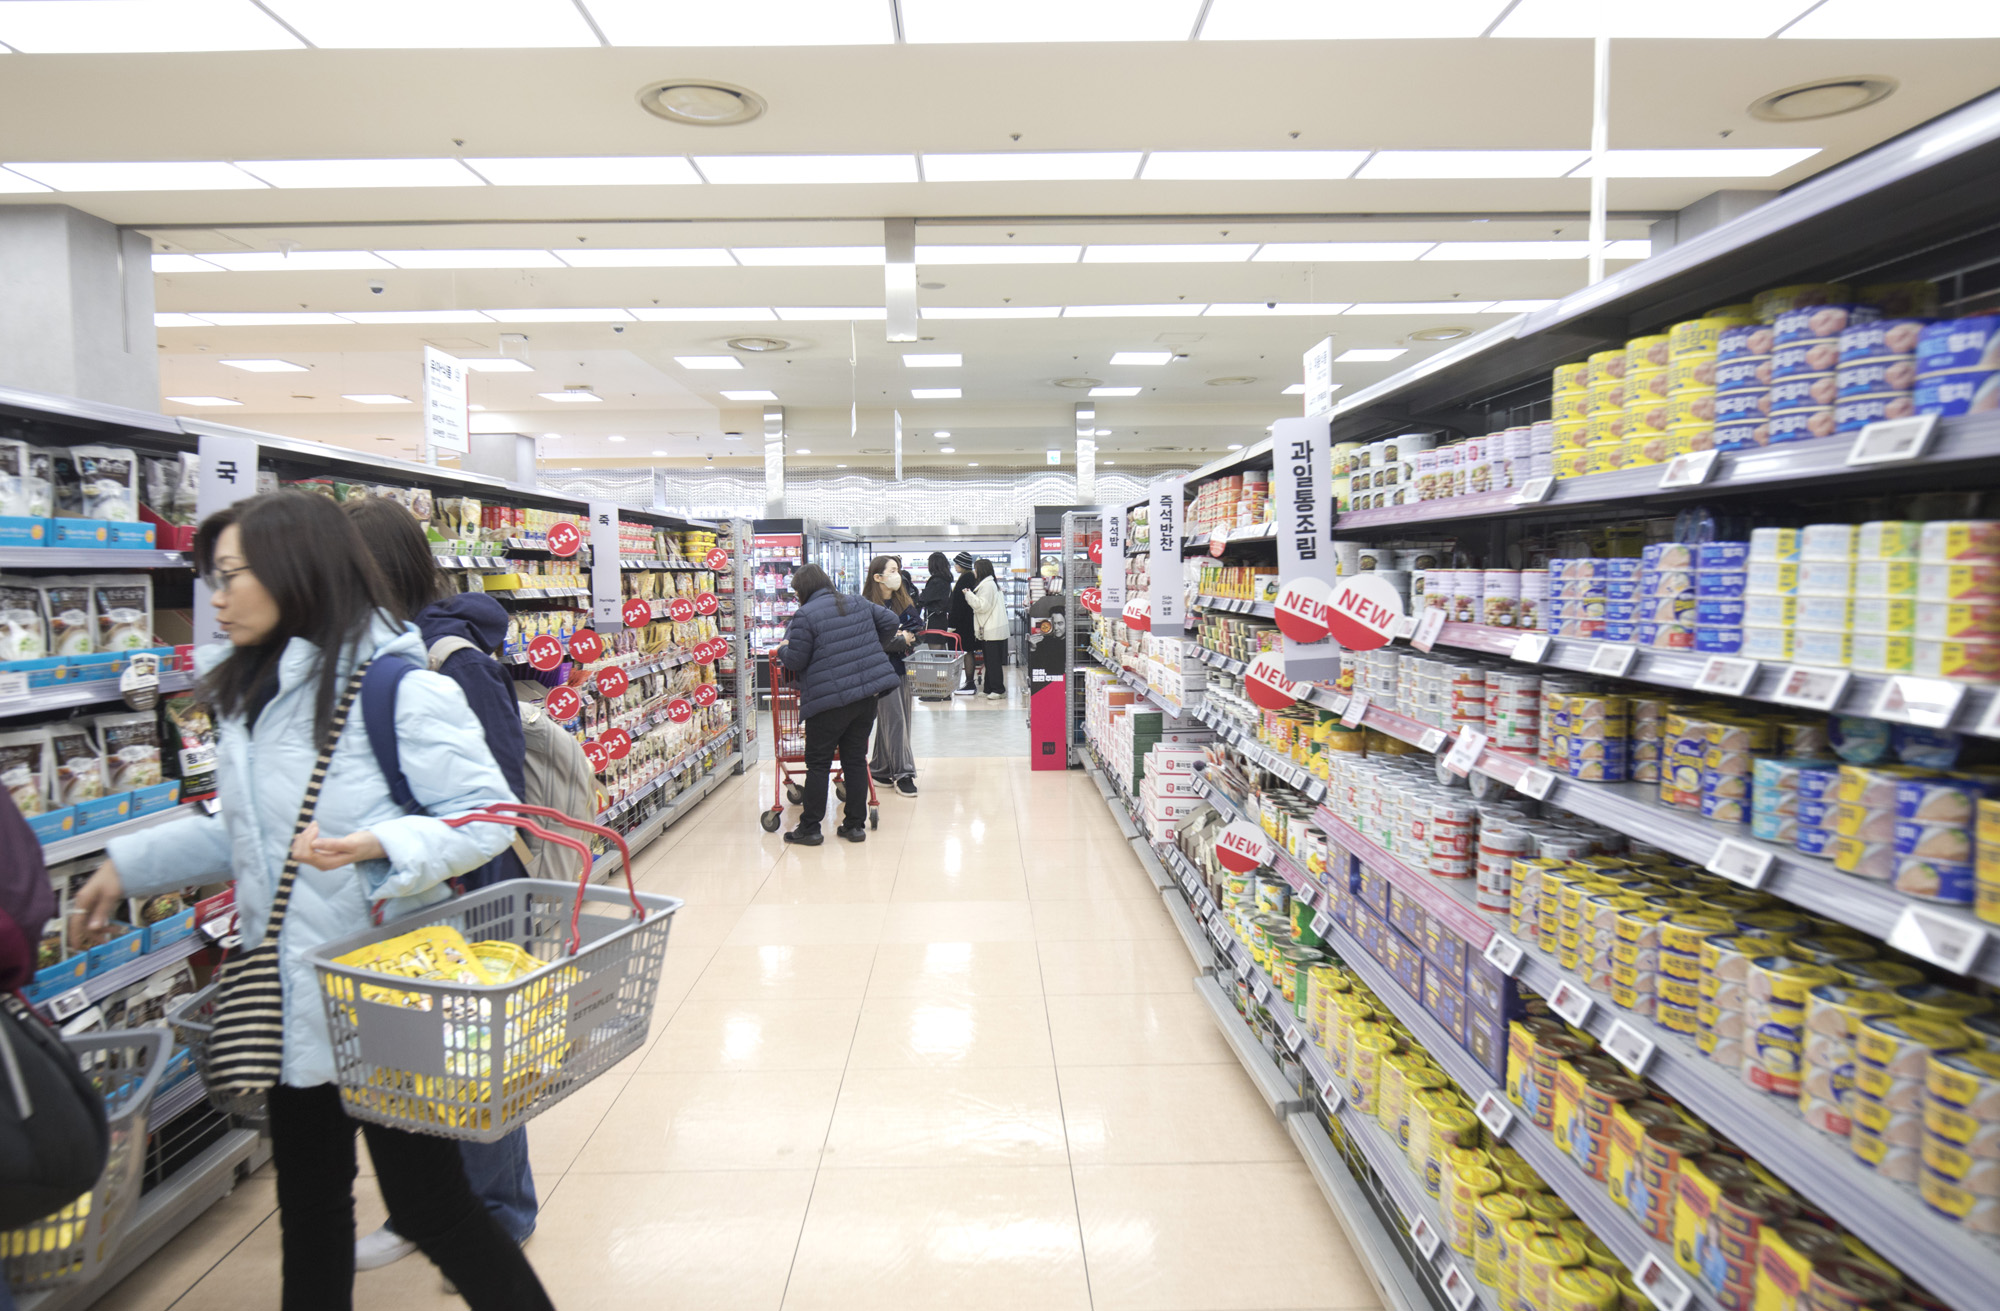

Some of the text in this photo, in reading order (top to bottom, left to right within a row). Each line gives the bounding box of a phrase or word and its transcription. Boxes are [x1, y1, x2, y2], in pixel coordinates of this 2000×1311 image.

[216, 461, 238, 484] 국
[1290, 440, 1317, 561] 과일통조림
[599, 514, 610, 526] 죽
[1159, 495, 1174, 552] 즉석반찬
[549, 528, 578, 550] 1+1
[1109, 516, 1120, 547] 즉석밥
[708, 551, 725, 567] 1+1
[625, 604, 648, 622] 2+1
[671, 604, 692, 617] 1+1
[698, 597, 716, 611] 1+1
[1127, 606, 1141, 617] NE
[1284, 590, 1328, 622] NEW
[1338, 588, 1395, 629] NEW
[531, 642, 560, 663] 1+1
[573, 637, 597, 655] 1+1
[695, 647, 713, 660] 1+1
[601, 673, 624, 691] 2+1
[1254, 661, 1297, 693] NEW
[549, 692, 577, 716] 1+1
[695, 688, 714, 705] 1+1
[669, 703, 690, 717] 1+1
[1223, 831, 1262, 857] NEW
[572, 992, 615, 1022] ZETTAPLEX
